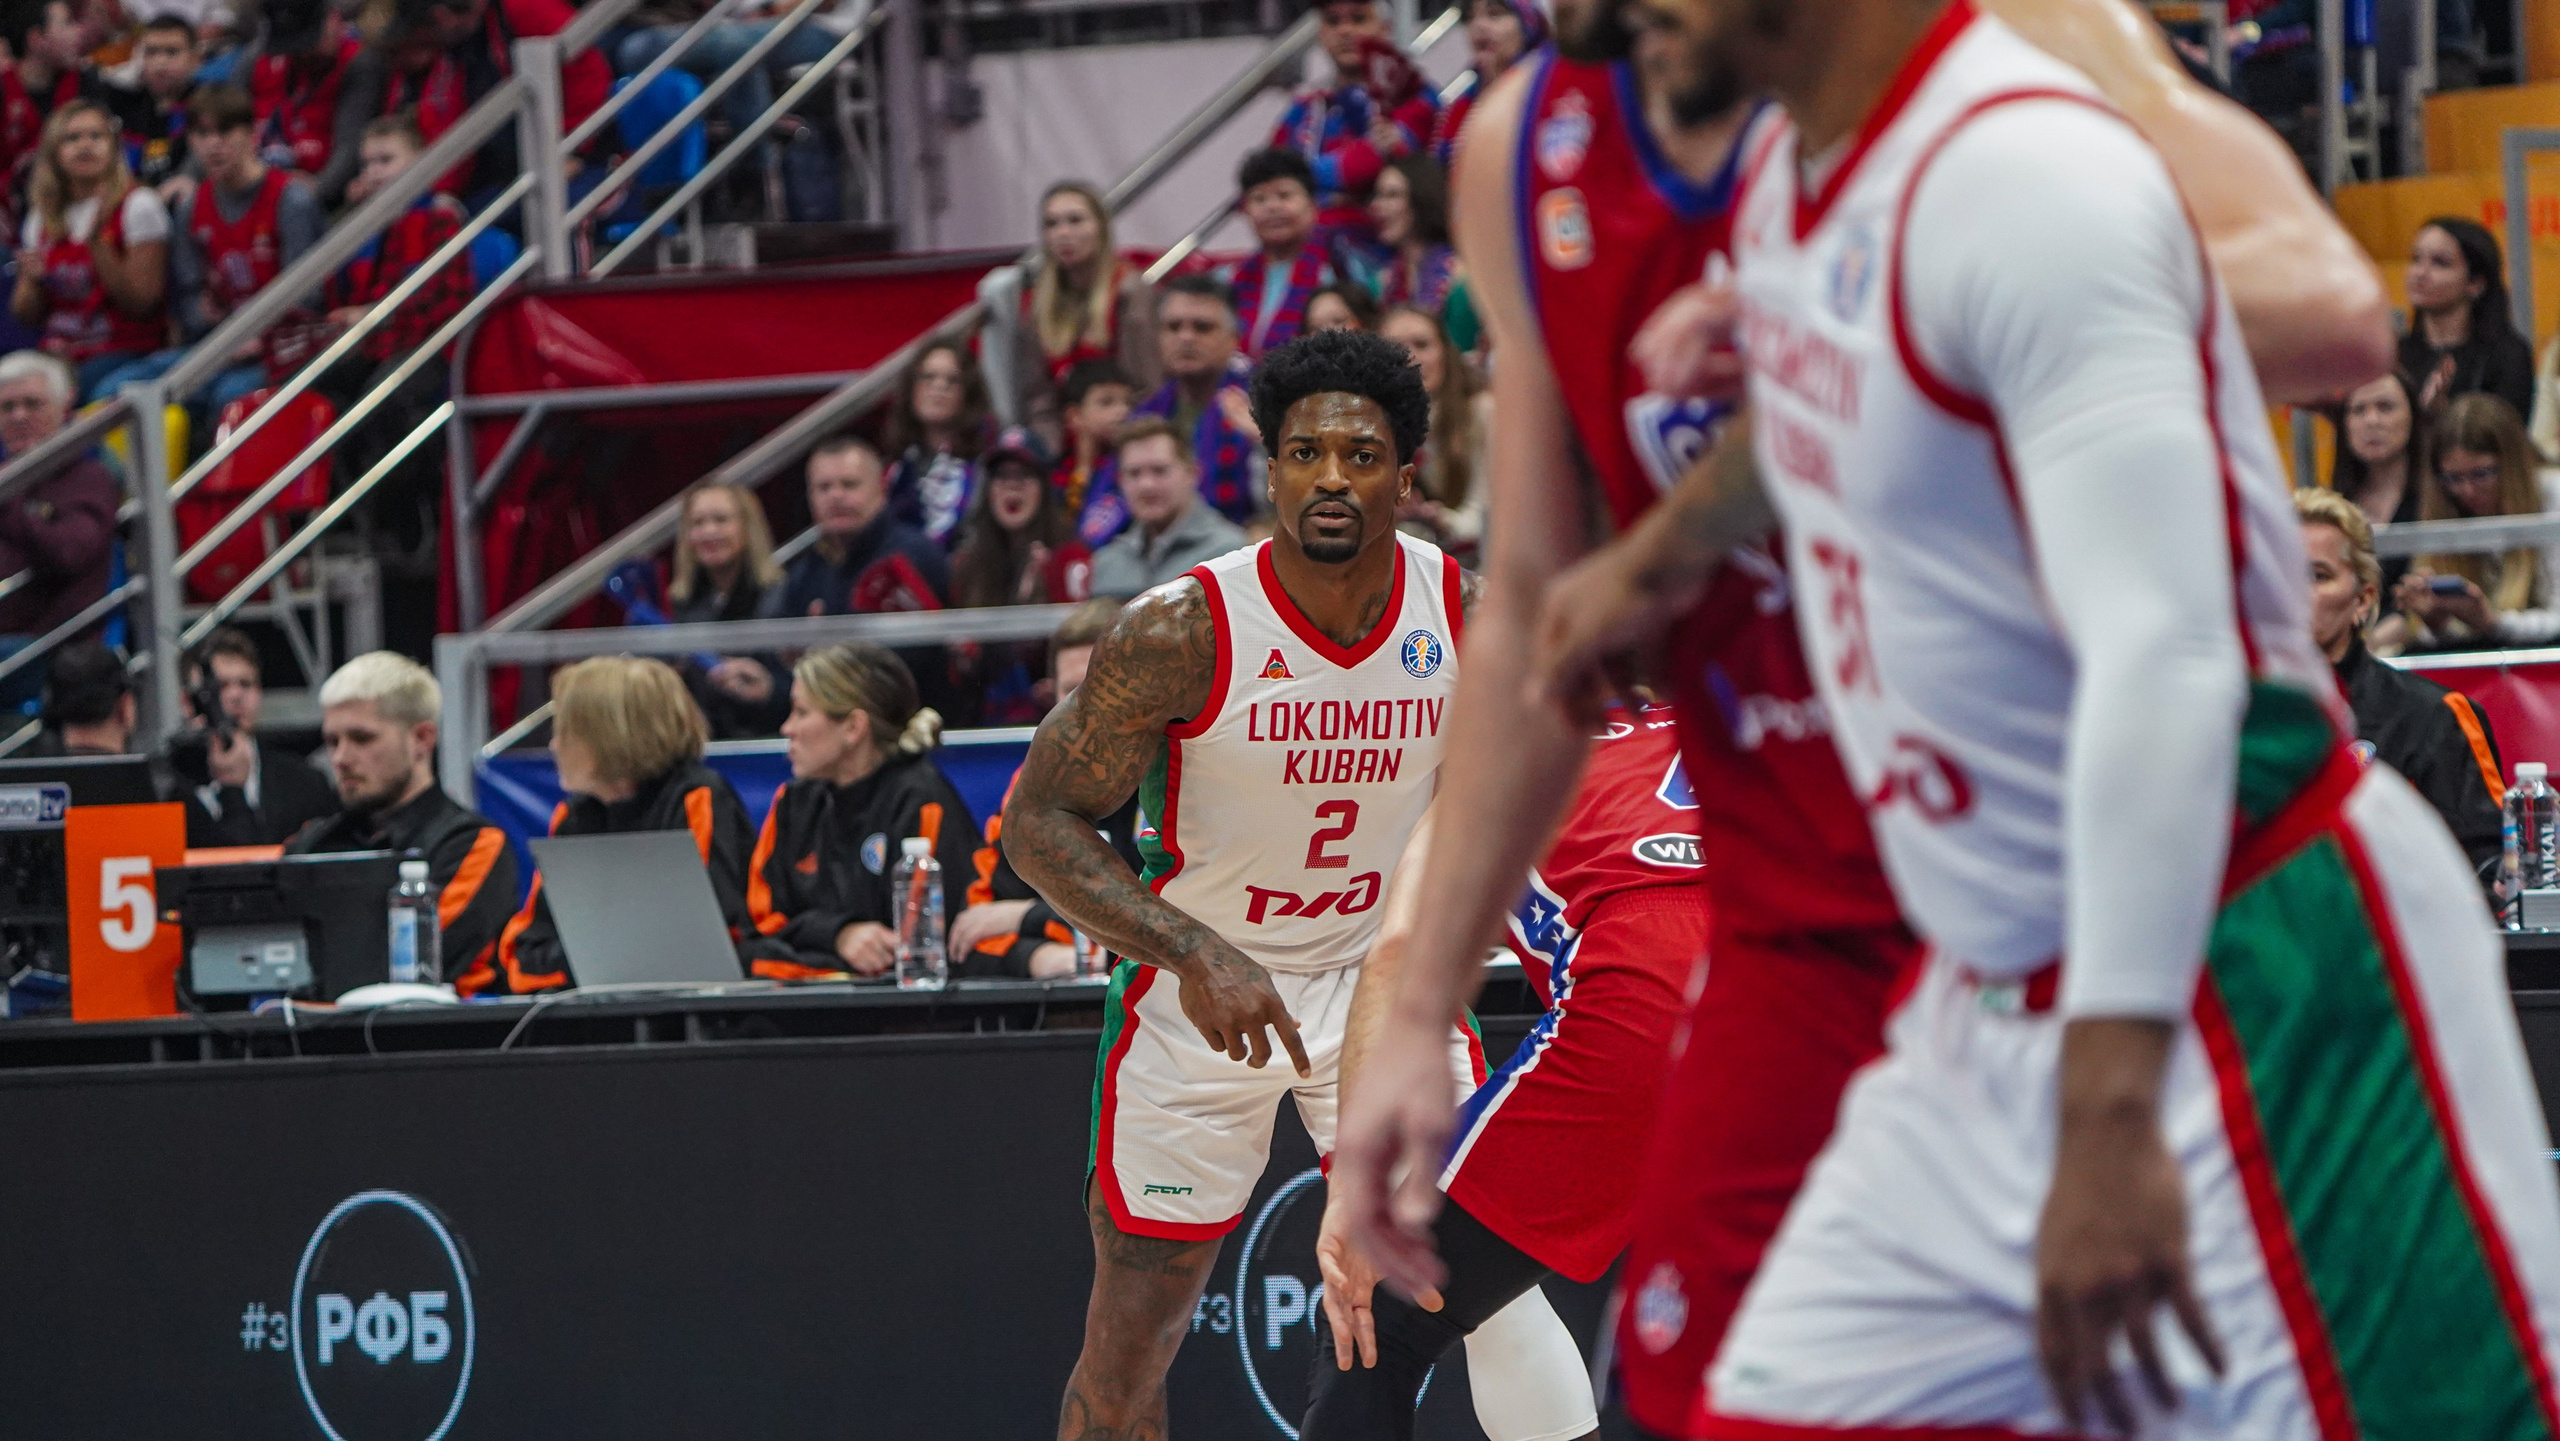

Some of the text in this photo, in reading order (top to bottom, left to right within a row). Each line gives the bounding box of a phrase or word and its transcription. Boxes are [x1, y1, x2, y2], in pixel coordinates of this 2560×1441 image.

[1248, 697, 1444, 742] LOKOMOTIV
[1283, 748, 1403, 784] KUBAN
[1304, 799, 1360, 869] 2
[100, 856, 157, 953] 5
[316, 1290, 452, 1365] РФБ
